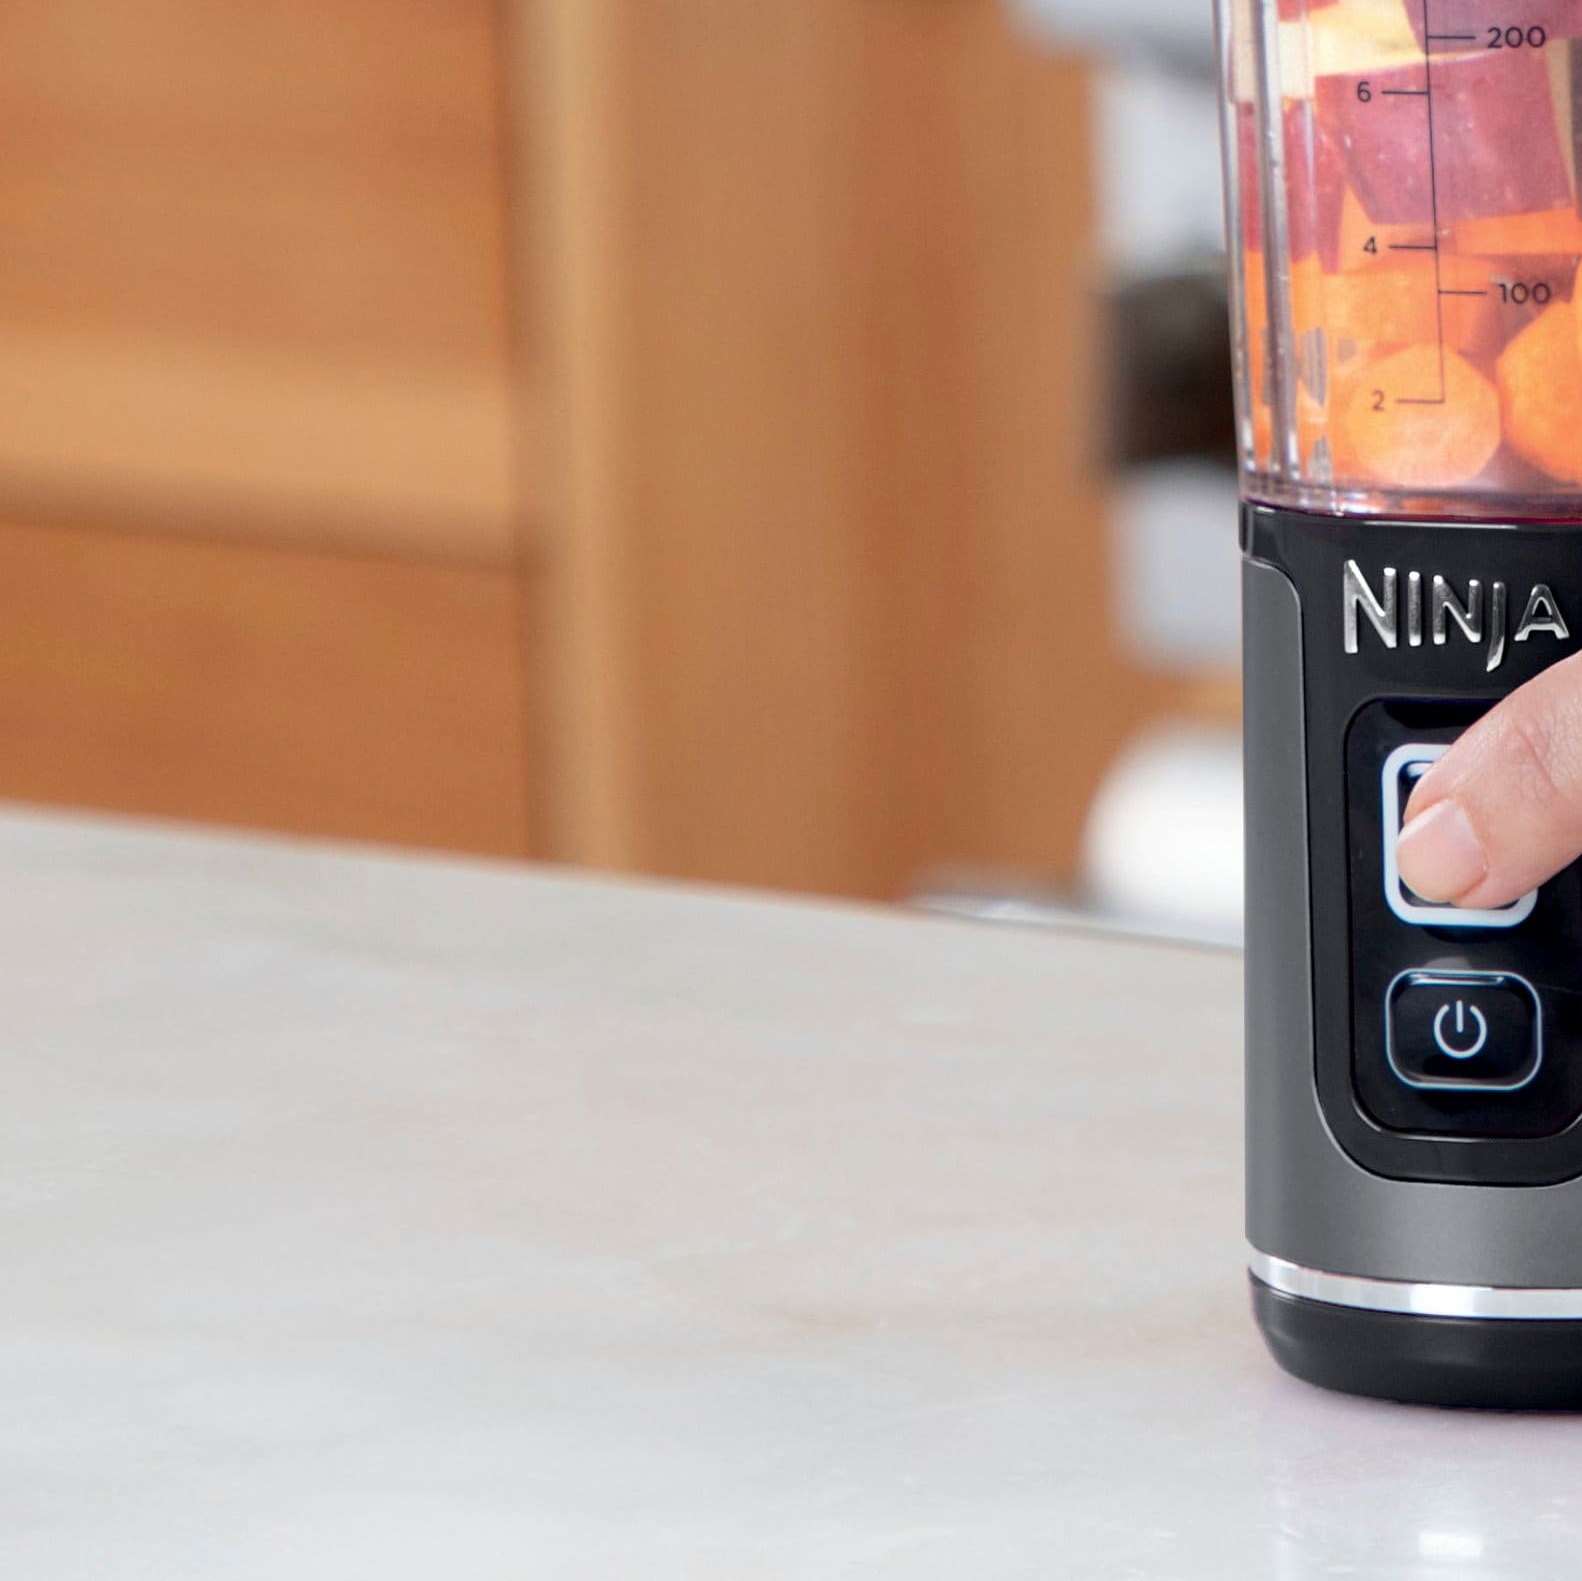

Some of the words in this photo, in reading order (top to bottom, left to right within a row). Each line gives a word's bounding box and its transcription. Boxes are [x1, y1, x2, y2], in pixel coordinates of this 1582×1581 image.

[1487, 26, 1546, 49] 200
[1356, 81, 1372, 103] 6
[1363, 236, 1378, 255] 4
[1498, 282, 1551, 305] 100
[1372, 390, 1385, 412] 2
[1344, 559, 1570, 673] NINJA
